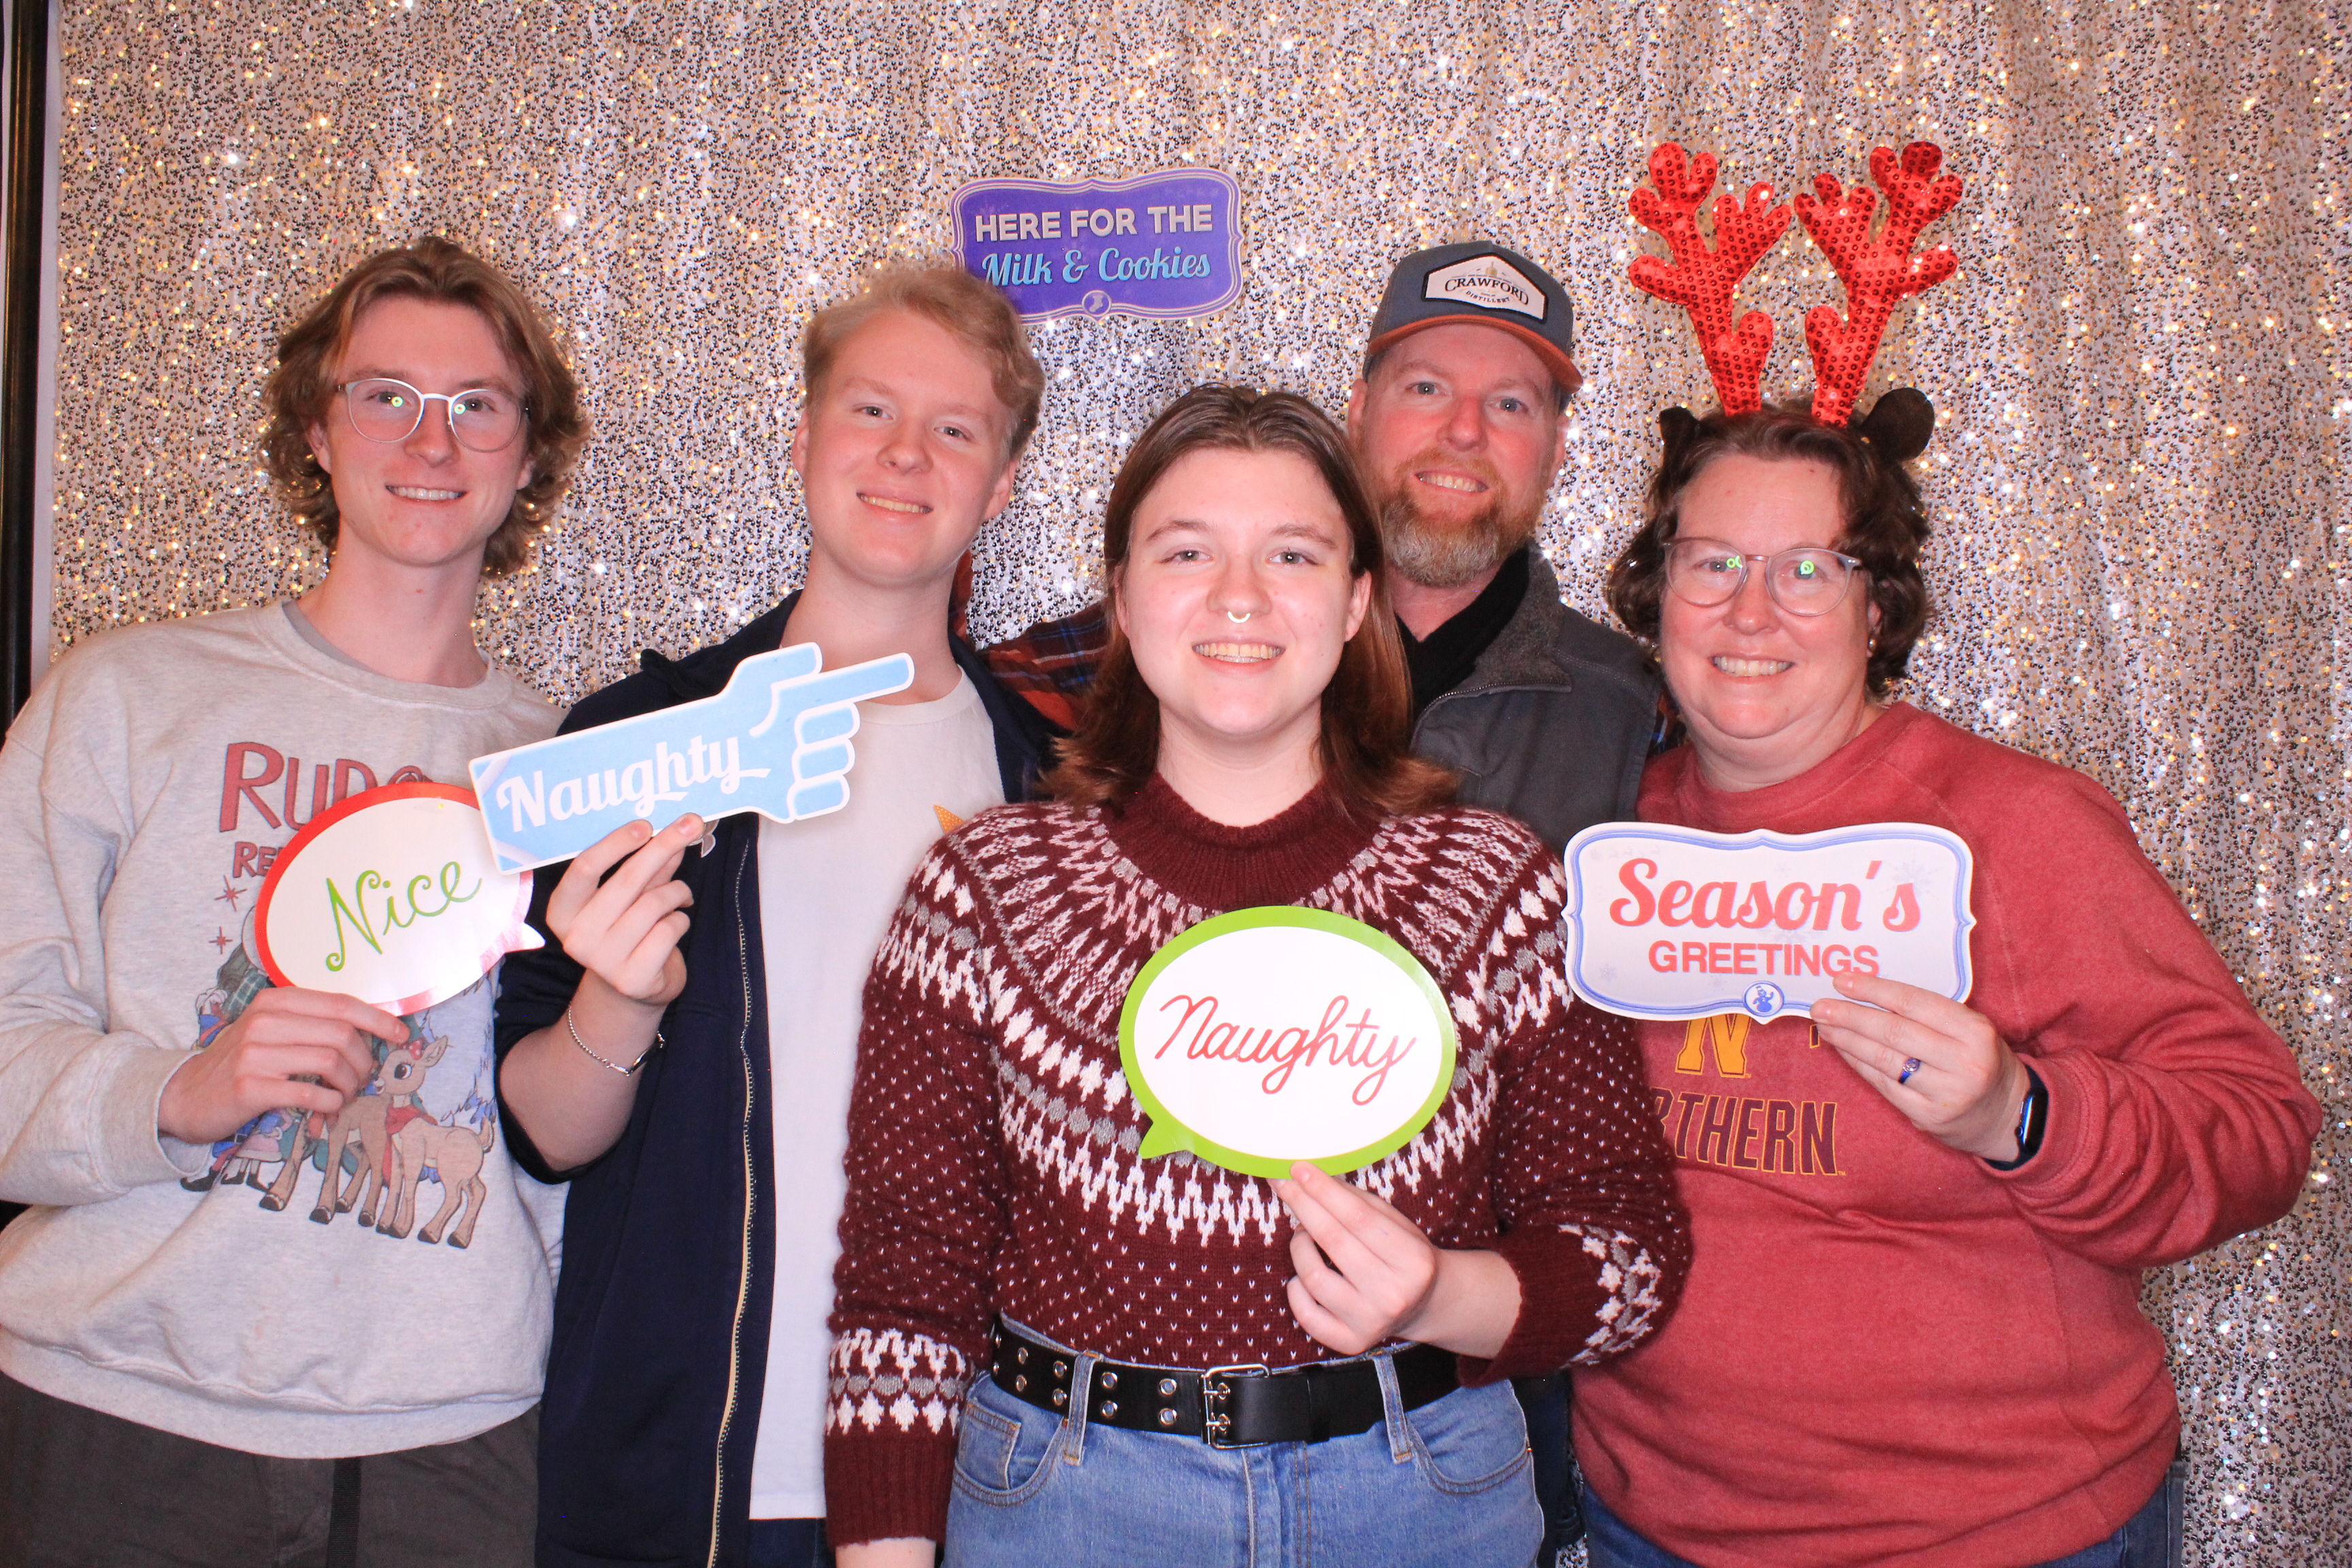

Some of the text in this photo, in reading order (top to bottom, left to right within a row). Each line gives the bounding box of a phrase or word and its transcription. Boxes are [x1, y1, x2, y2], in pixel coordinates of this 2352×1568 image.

[975, 203, 1213, 242] HERE FOR THE
[981, 246, 1211, 287] Milk & Cookies
[1444, 277, 1529, 306] CRAWFORD
[1465, 290, 1511, 304] DISTILLERY
[218, 741, 424, 832] RUD
[495, 734, 772, 832] Naughty
[233, 841, 284, 878] RE
[1609, 858, 1921, 932] Season's
[325, 861, 483, 972] Nice
[1648, 940, 1880, 977] GREETINGS
[1154, 994, 1418, 1107] Naughty
